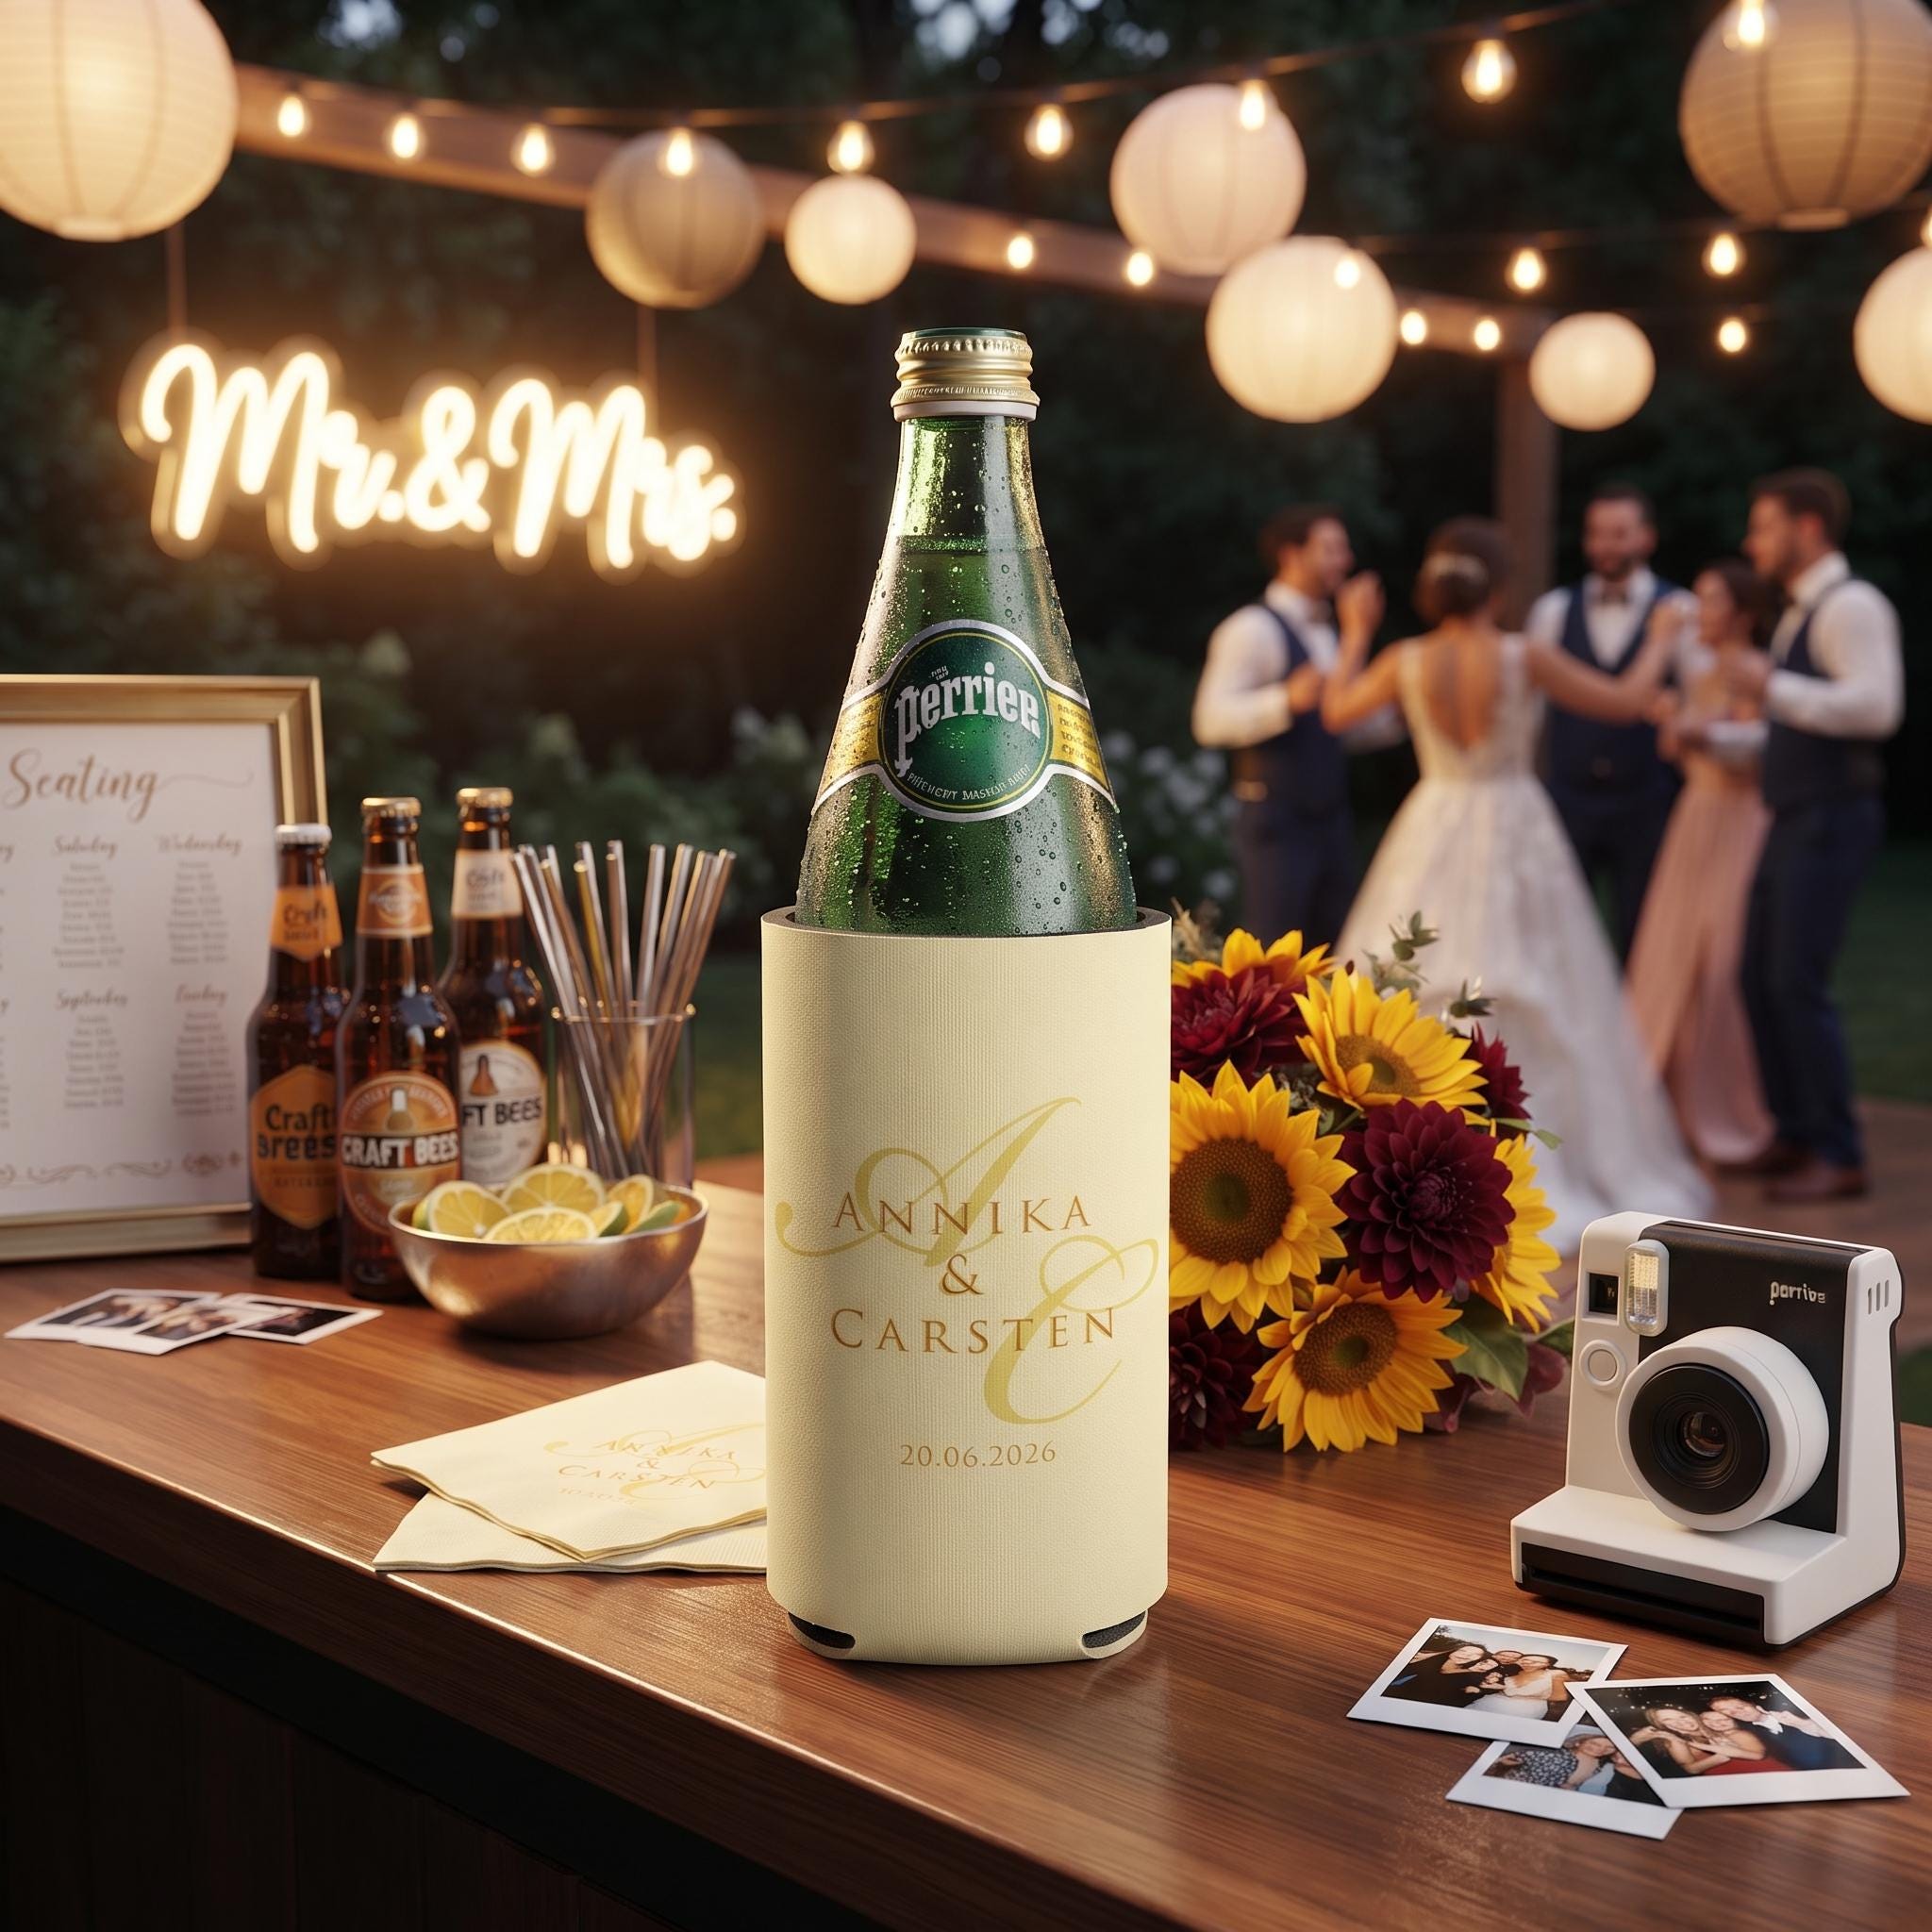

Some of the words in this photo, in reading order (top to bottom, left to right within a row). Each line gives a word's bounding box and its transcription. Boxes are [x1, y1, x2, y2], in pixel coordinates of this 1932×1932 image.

[341, 1136, 411, 1168] CRAFT
[834, 1191, 1091, 1237] ANNIKA
[939, 1254, 985, 1296] &
[830, 1307, 1115, 1355] CARSTEN
[900, 1441, 1057, 1468] 20.06.2026
